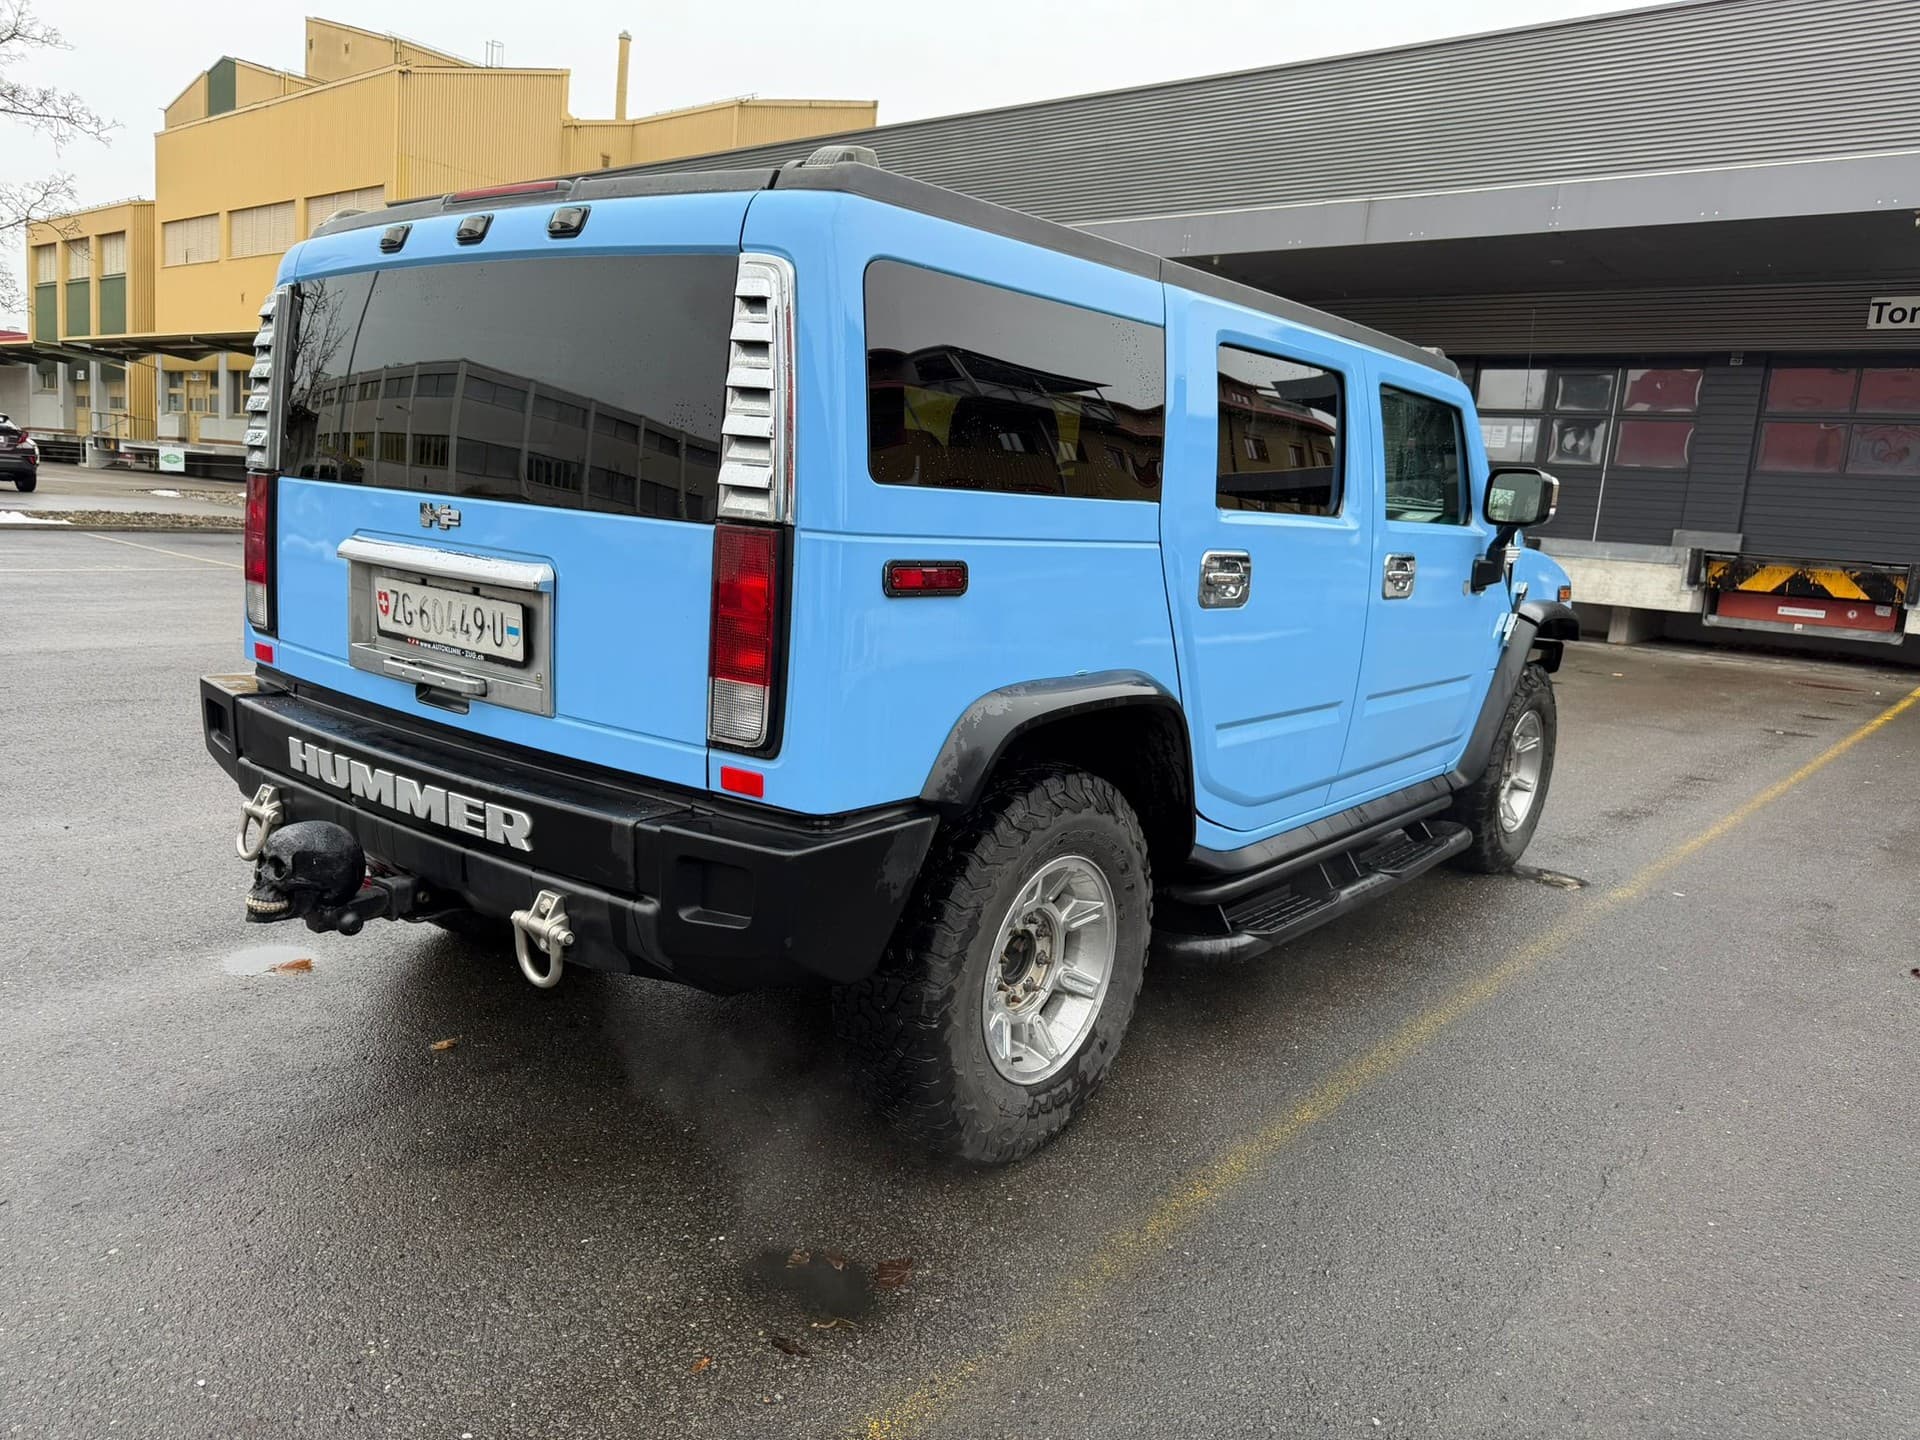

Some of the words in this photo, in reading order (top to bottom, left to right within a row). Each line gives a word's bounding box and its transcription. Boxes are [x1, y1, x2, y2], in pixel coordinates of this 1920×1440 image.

[1871, 301, 1920, 324] Tor
[420, 502, 461, 529] H2
[288, 736, 533, 852] HUMMER
